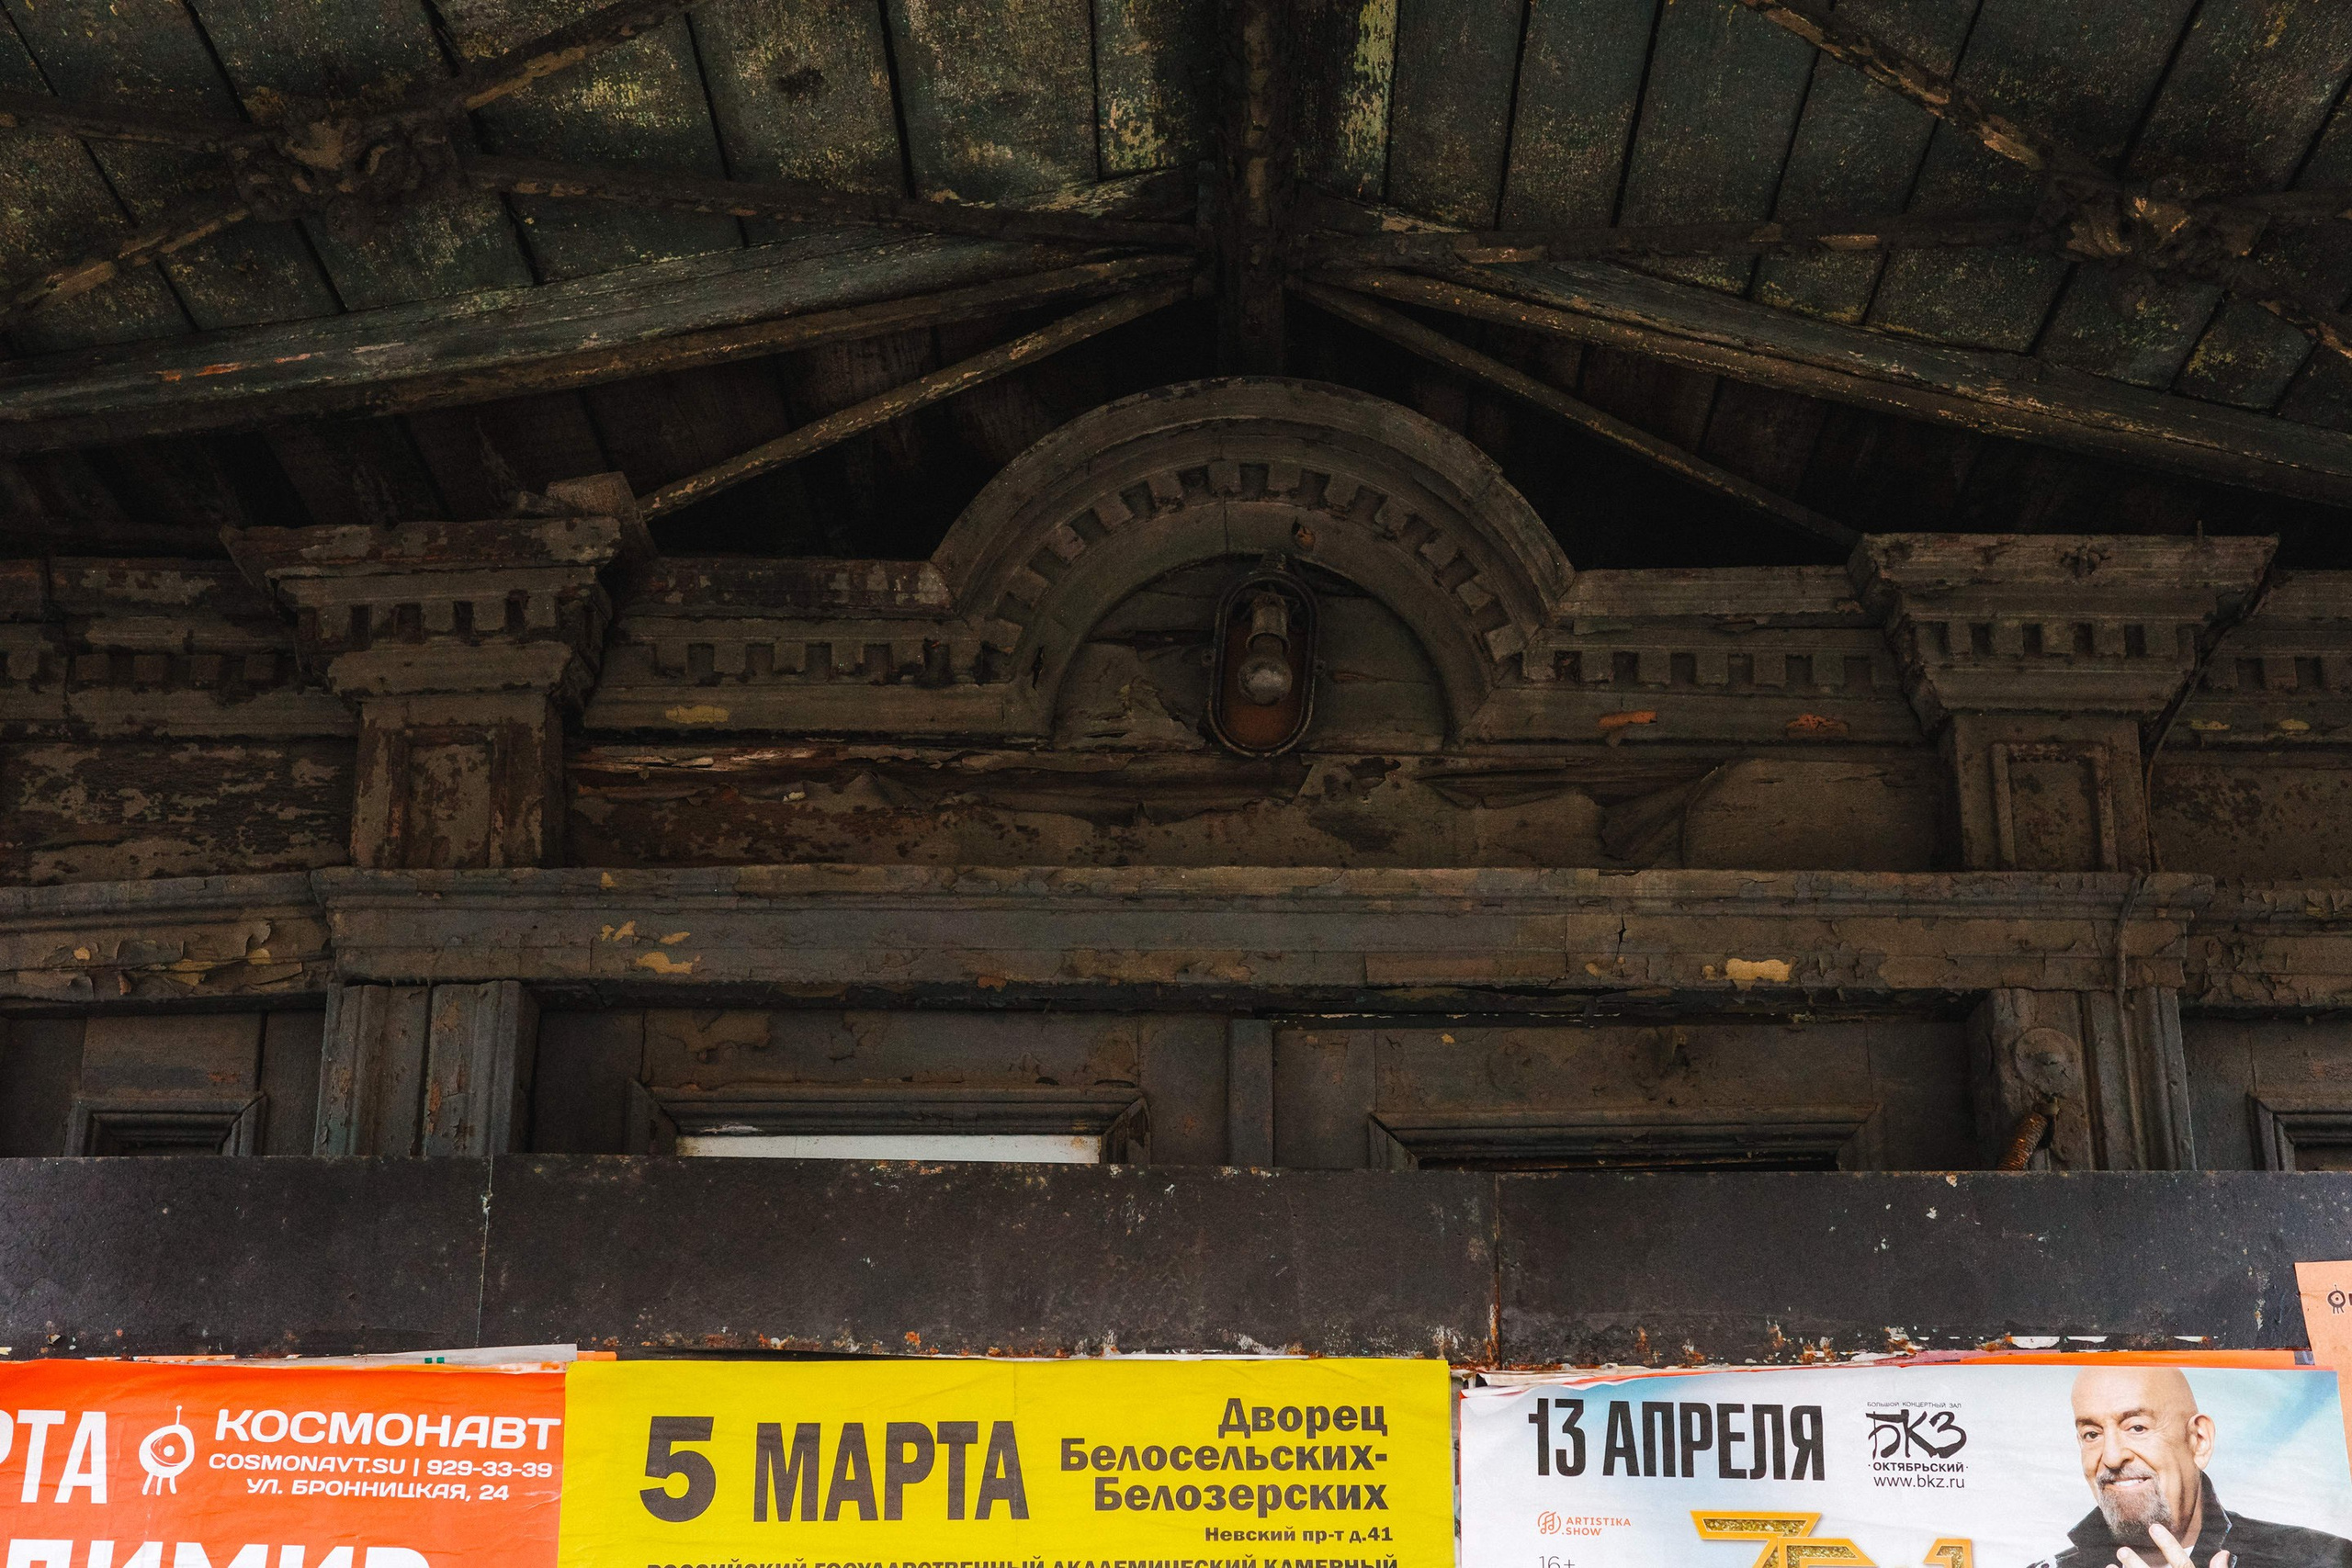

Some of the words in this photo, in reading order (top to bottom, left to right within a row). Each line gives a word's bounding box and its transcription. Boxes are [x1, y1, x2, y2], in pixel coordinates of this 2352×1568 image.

[215, 1408, 561, 1450] КОСМОНАВТ
[1218, 1397, 1388, 1439] Дворец
[1865, 1408, 1967, 1461] БКЗ
[1060, 1438, 1388, 1472] Белосельских-
[1529, 1398, 1586, 1477] 13
[1602, 1401, 1826, 1482] АПРЕЛЯ
[209, 1452, 406, 1475] COSMONAVT.SU
[426, 1459, 553, 1479] 929-33-39
[639, 1416, 717, 1523] 5
[753, 1420, 1030, 1523] МАРТА
[1872, 1461, 1964, 1472] ОКТЯБРЬСКИЙ
[1873, 1474, 1965, 1489] www.bkz.ru
[246, 1478, 283, 1495] УЛ.
[291, 1479, 471, 1503] БРОННИЦКАЯ,
[479, 1484, 510, 1502] 24
[1094, 1477, 1389, 1519] Белозерских
[1204, 1526, 1295, 1542] Невский
[1302, 1529, 1345, 1545] пр-т
[1349, 1527, 1394, 1544] д.41
[1566, 1517, 1632, 1527] ARTISTIKA
